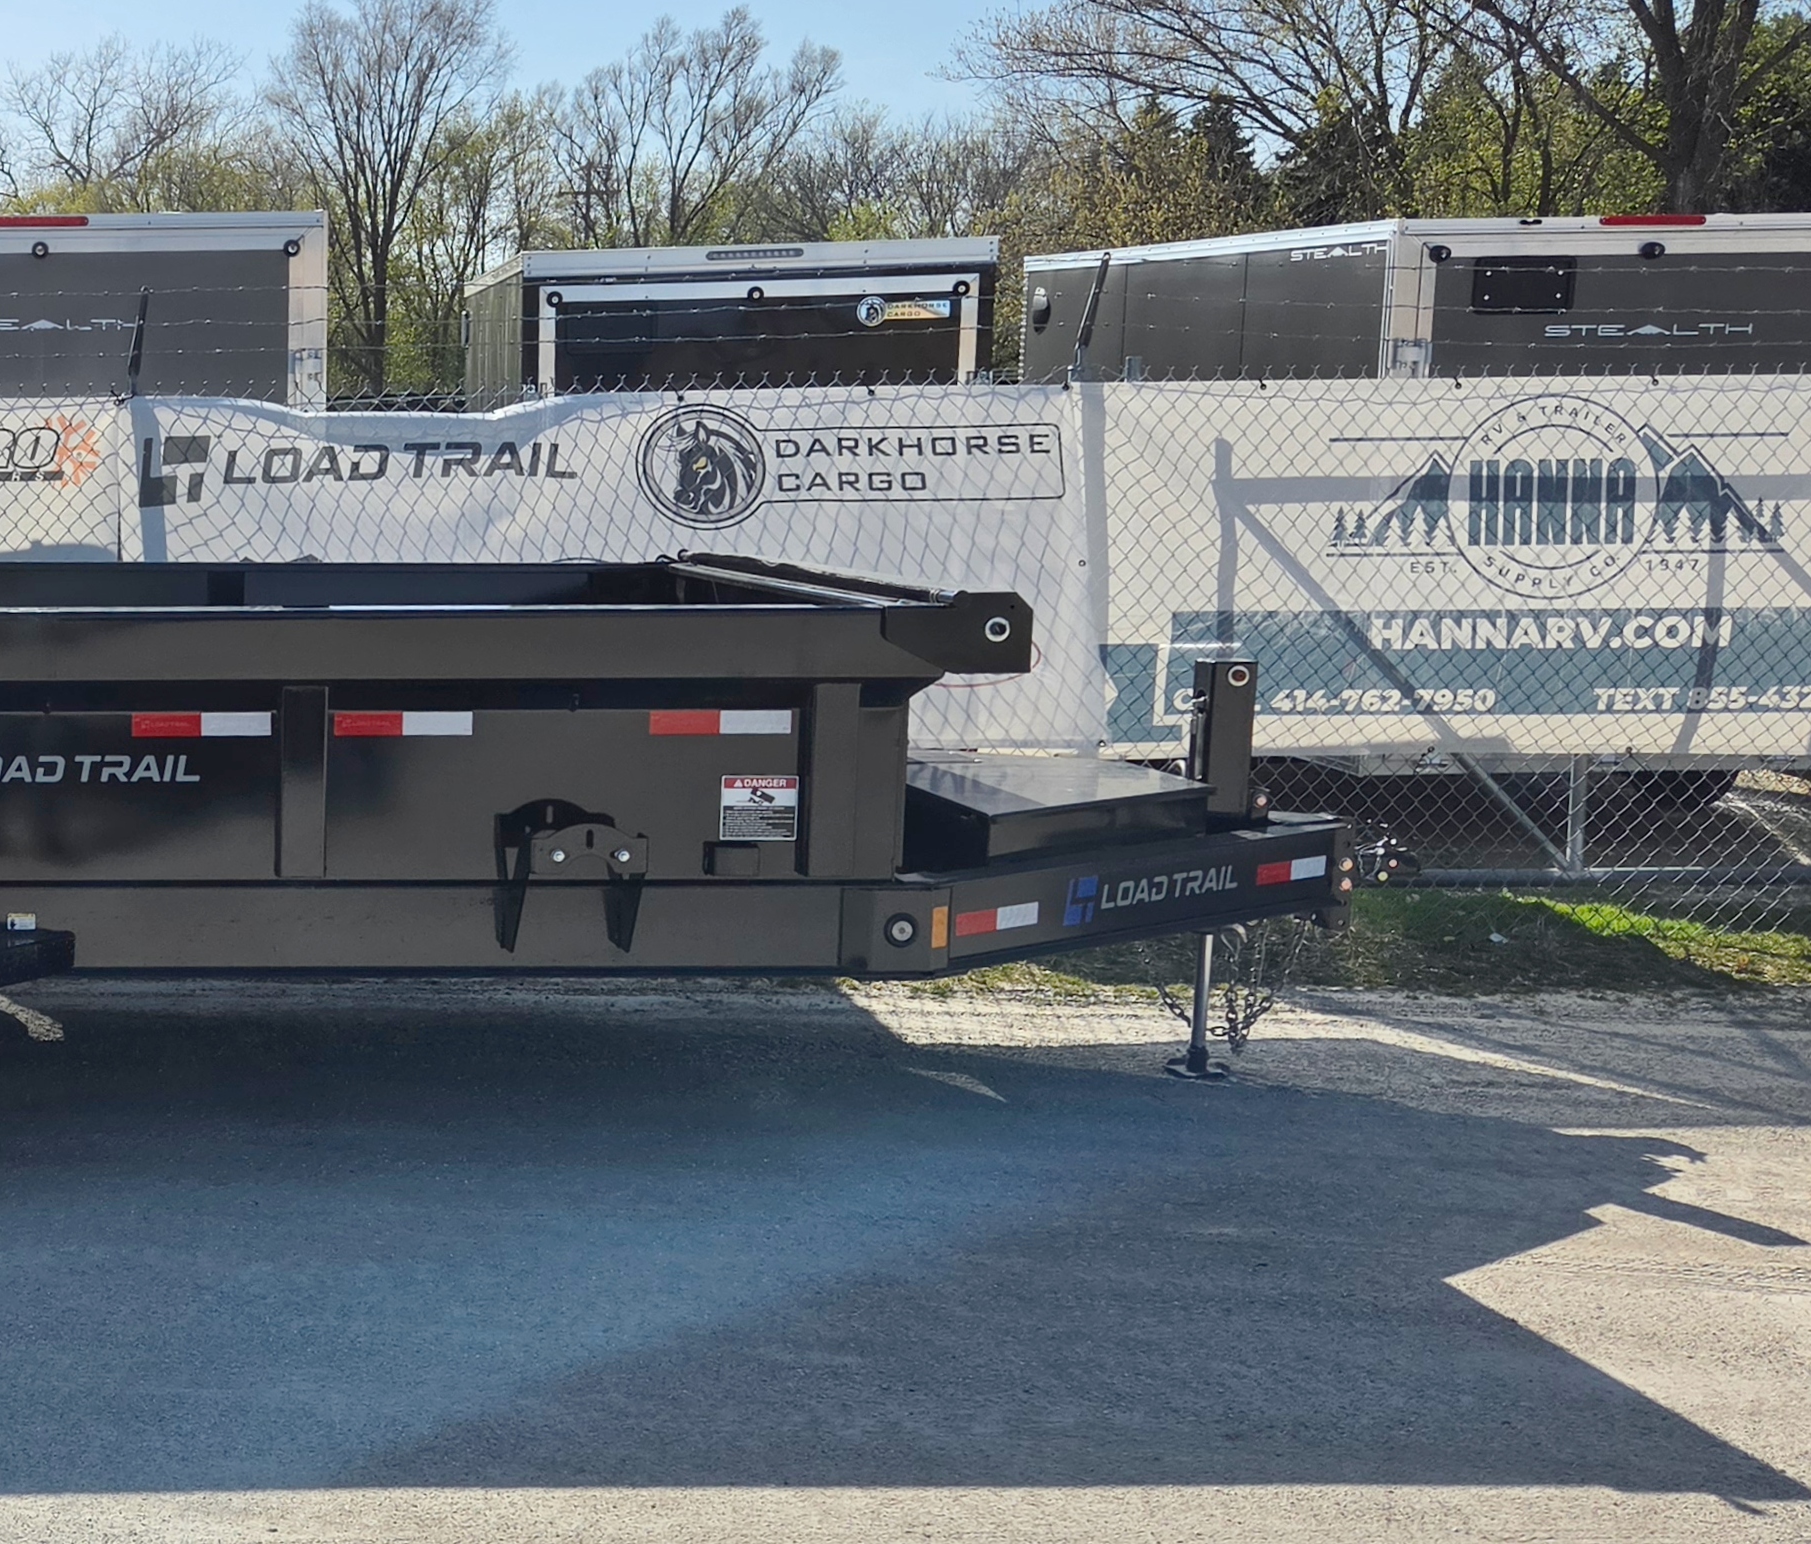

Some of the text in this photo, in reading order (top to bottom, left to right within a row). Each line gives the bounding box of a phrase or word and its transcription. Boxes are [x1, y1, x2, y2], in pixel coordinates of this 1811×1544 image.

[1290, 243, 1387, 262] STEALTH
[1543, 322, 1755, 337] STEALTH
[1539, 404, 1628, 445] TRAILER
[774, 432, 1053, 460] DARKHORSE
[222, 440, 578, 485] LOAD TRAIL
[777, 470, 928, 493] CARGO
[1468, 457, 1638, 546] HANNA
[1409, 560, 1458, 575] EST.
[1483, 555, 1575, 589] SUPPLY
[1370, 615, 1734, 651] HANNARV.COM
[1270, 687, 1496, 713] 414-762-7950
[1593, 686, 1682, 711] TEXT
[74, 753, 201, 783] TRAIL
[743, 778, 787, 788] DANGER
[1100, 865, 1238, 910] LOAD TRAIL
